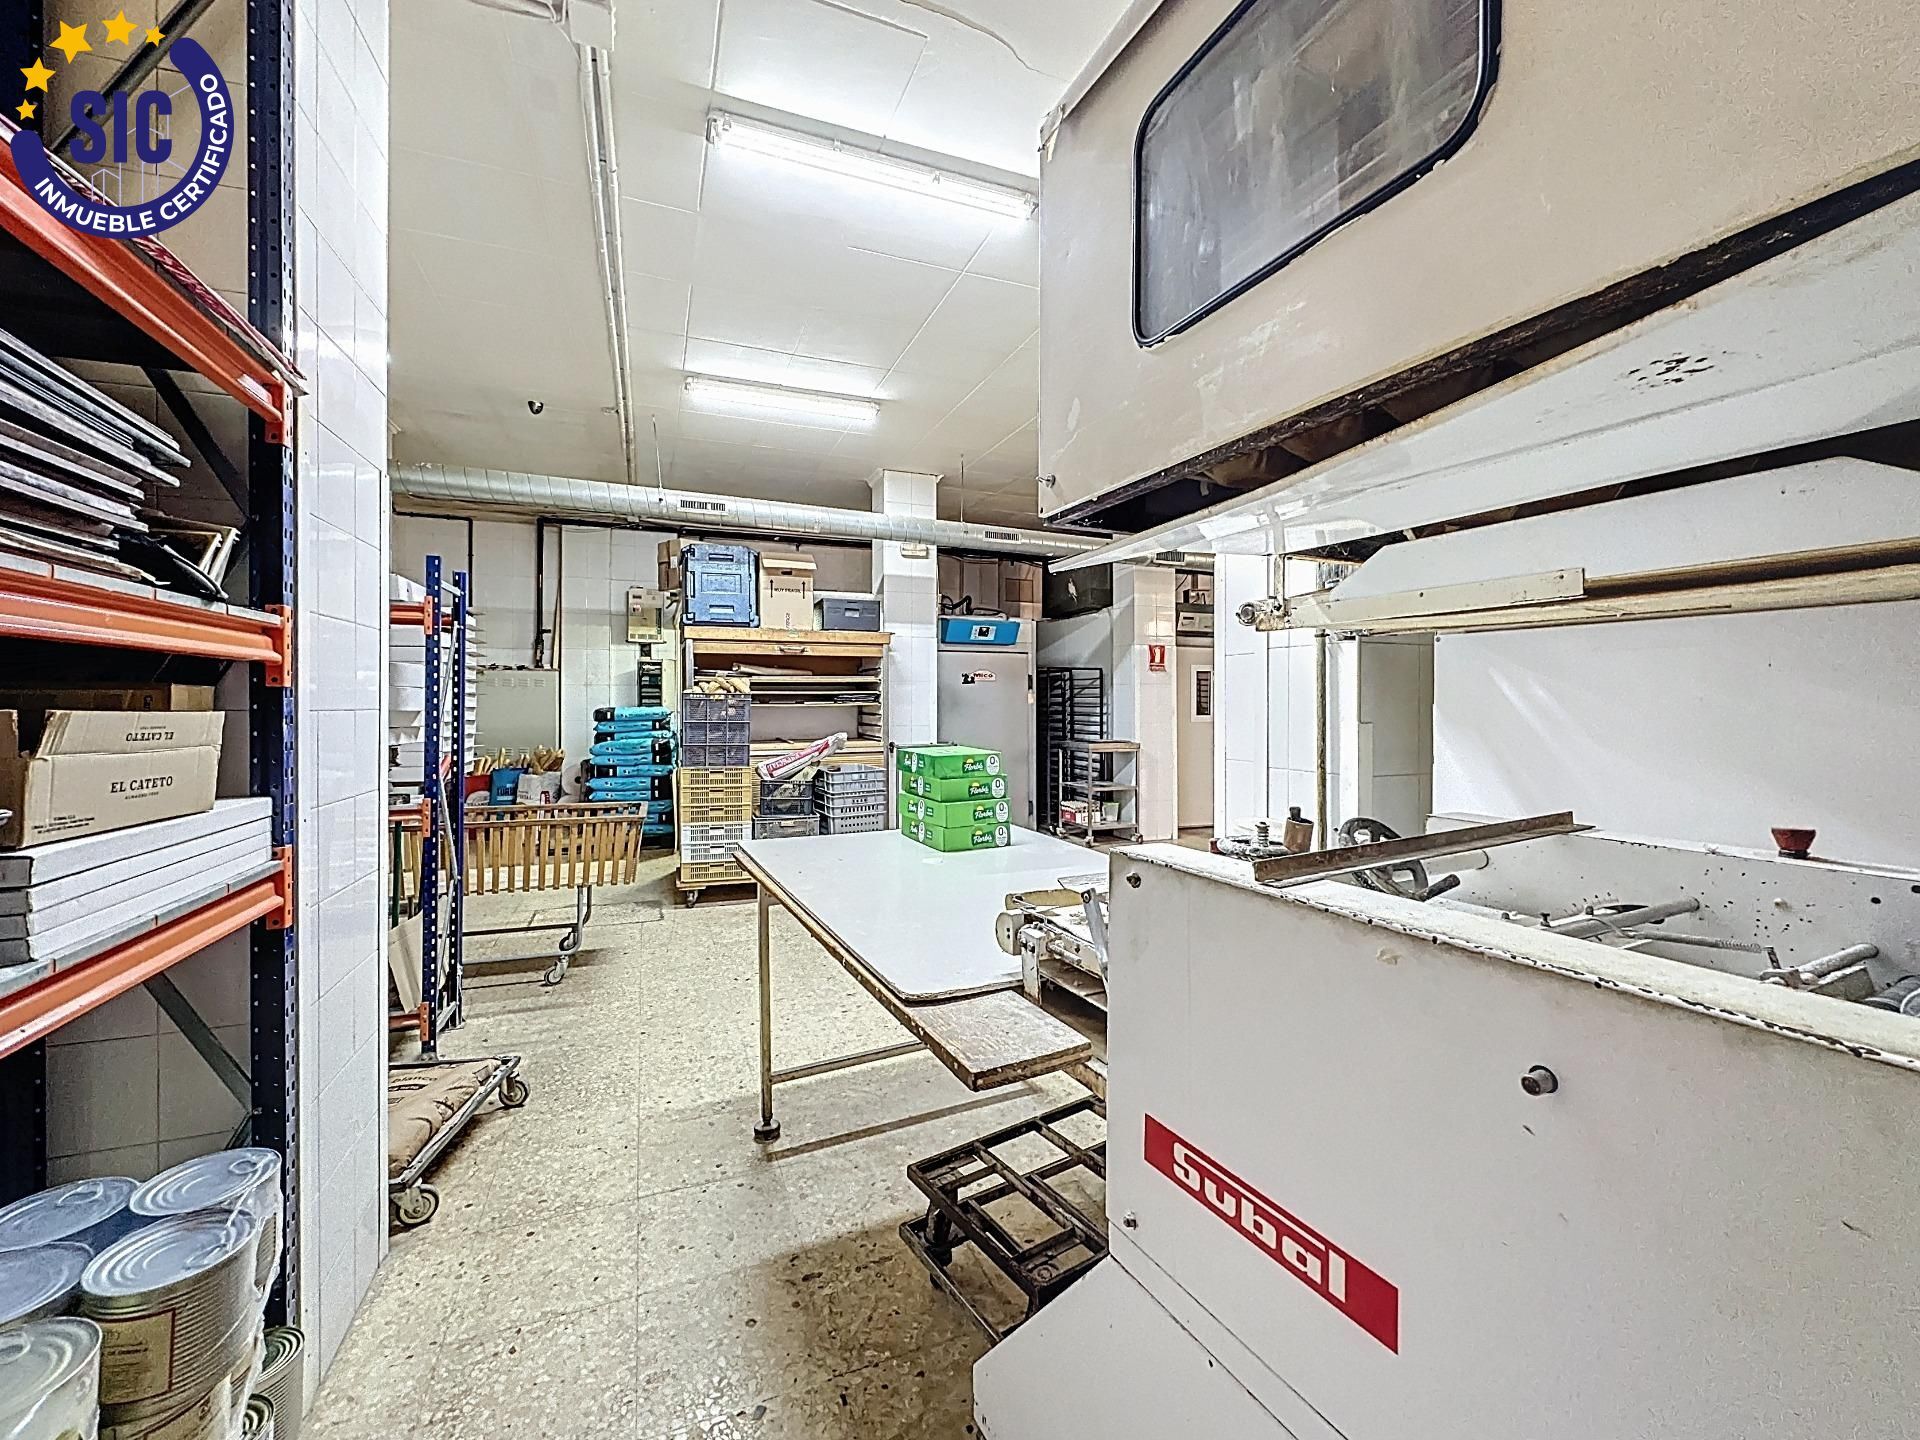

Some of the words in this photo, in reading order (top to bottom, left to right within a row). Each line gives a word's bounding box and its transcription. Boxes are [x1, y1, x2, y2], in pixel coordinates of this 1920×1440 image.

[126, 732, 162, 741] CATETO
[164, 731, 174, 740] EL
[110, 781, 126, 793] EL
[129, 776, 173, 791] CATETO
[1172, 1141, 1347, 1304] Subal
